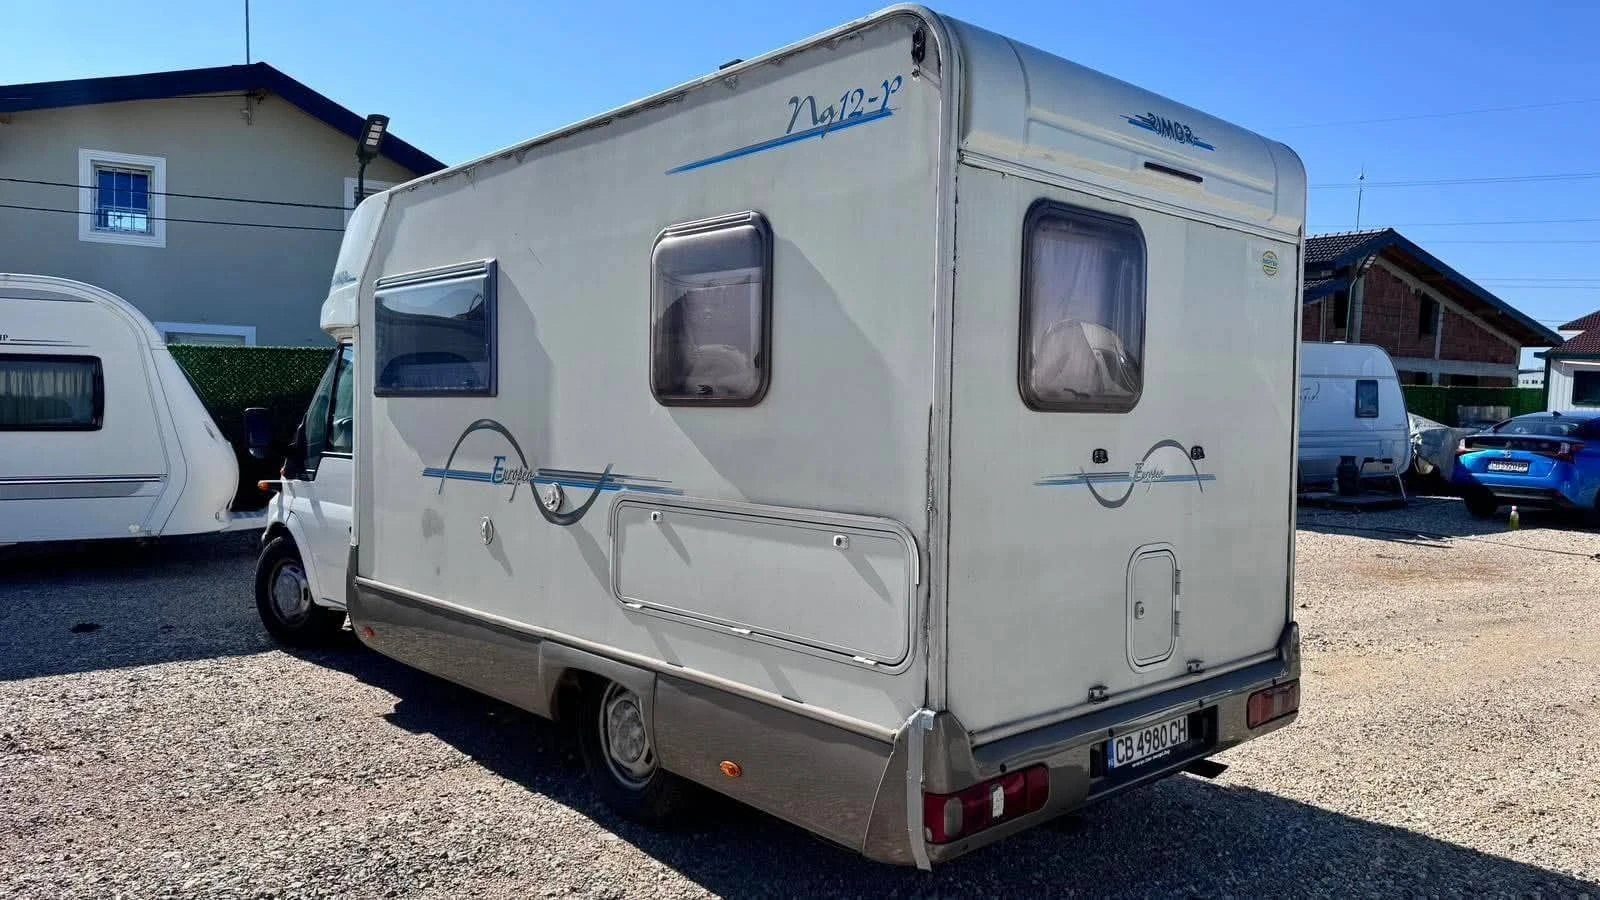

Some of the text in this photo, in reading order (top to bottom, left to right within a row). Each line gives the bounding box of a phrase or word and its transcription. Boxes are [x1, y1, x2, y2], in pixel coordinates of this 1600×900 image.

[1116, 736, 1134, 763] CB
[1137, 725, 1168, 756] 4980
[1169, 717, 1187, 744] CH
